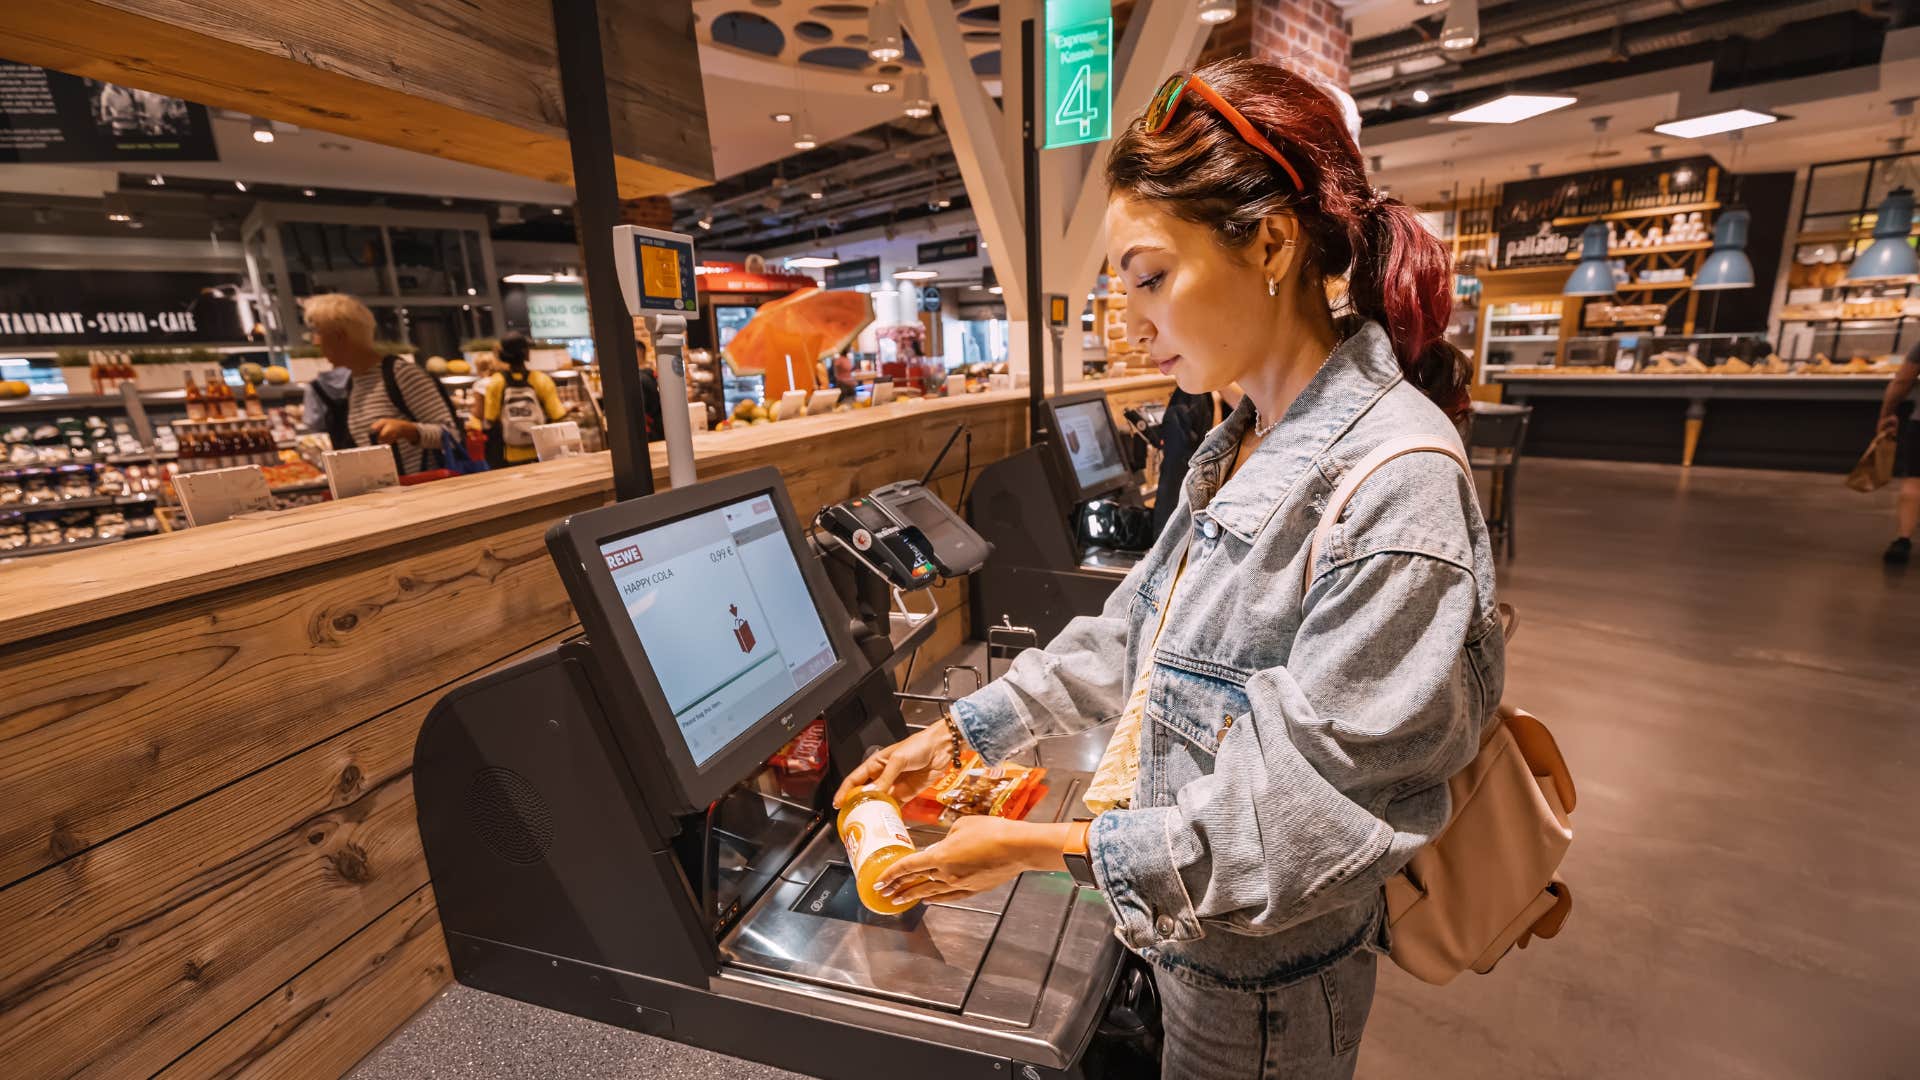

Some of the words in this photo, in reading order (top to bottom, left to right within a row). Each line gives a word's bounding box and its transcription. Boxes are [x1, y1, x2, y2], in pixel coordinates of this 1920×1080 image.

[1054, 30, 1098, 49] Express
[1060, 49, 1095, 64] Kasse
[1055, 63, 1098, 137] 4
[0, 312, 85, 334] TAURANT
[96, 312, 148, 333] SUSHI
[606, 547, 642, 569] REWE
[709, 549, 727, 563] 0,99
[727, 546, 735, 556] €
[623, 576, 651, 595] HAPPY
[652, 568, 674, 584] COLA
